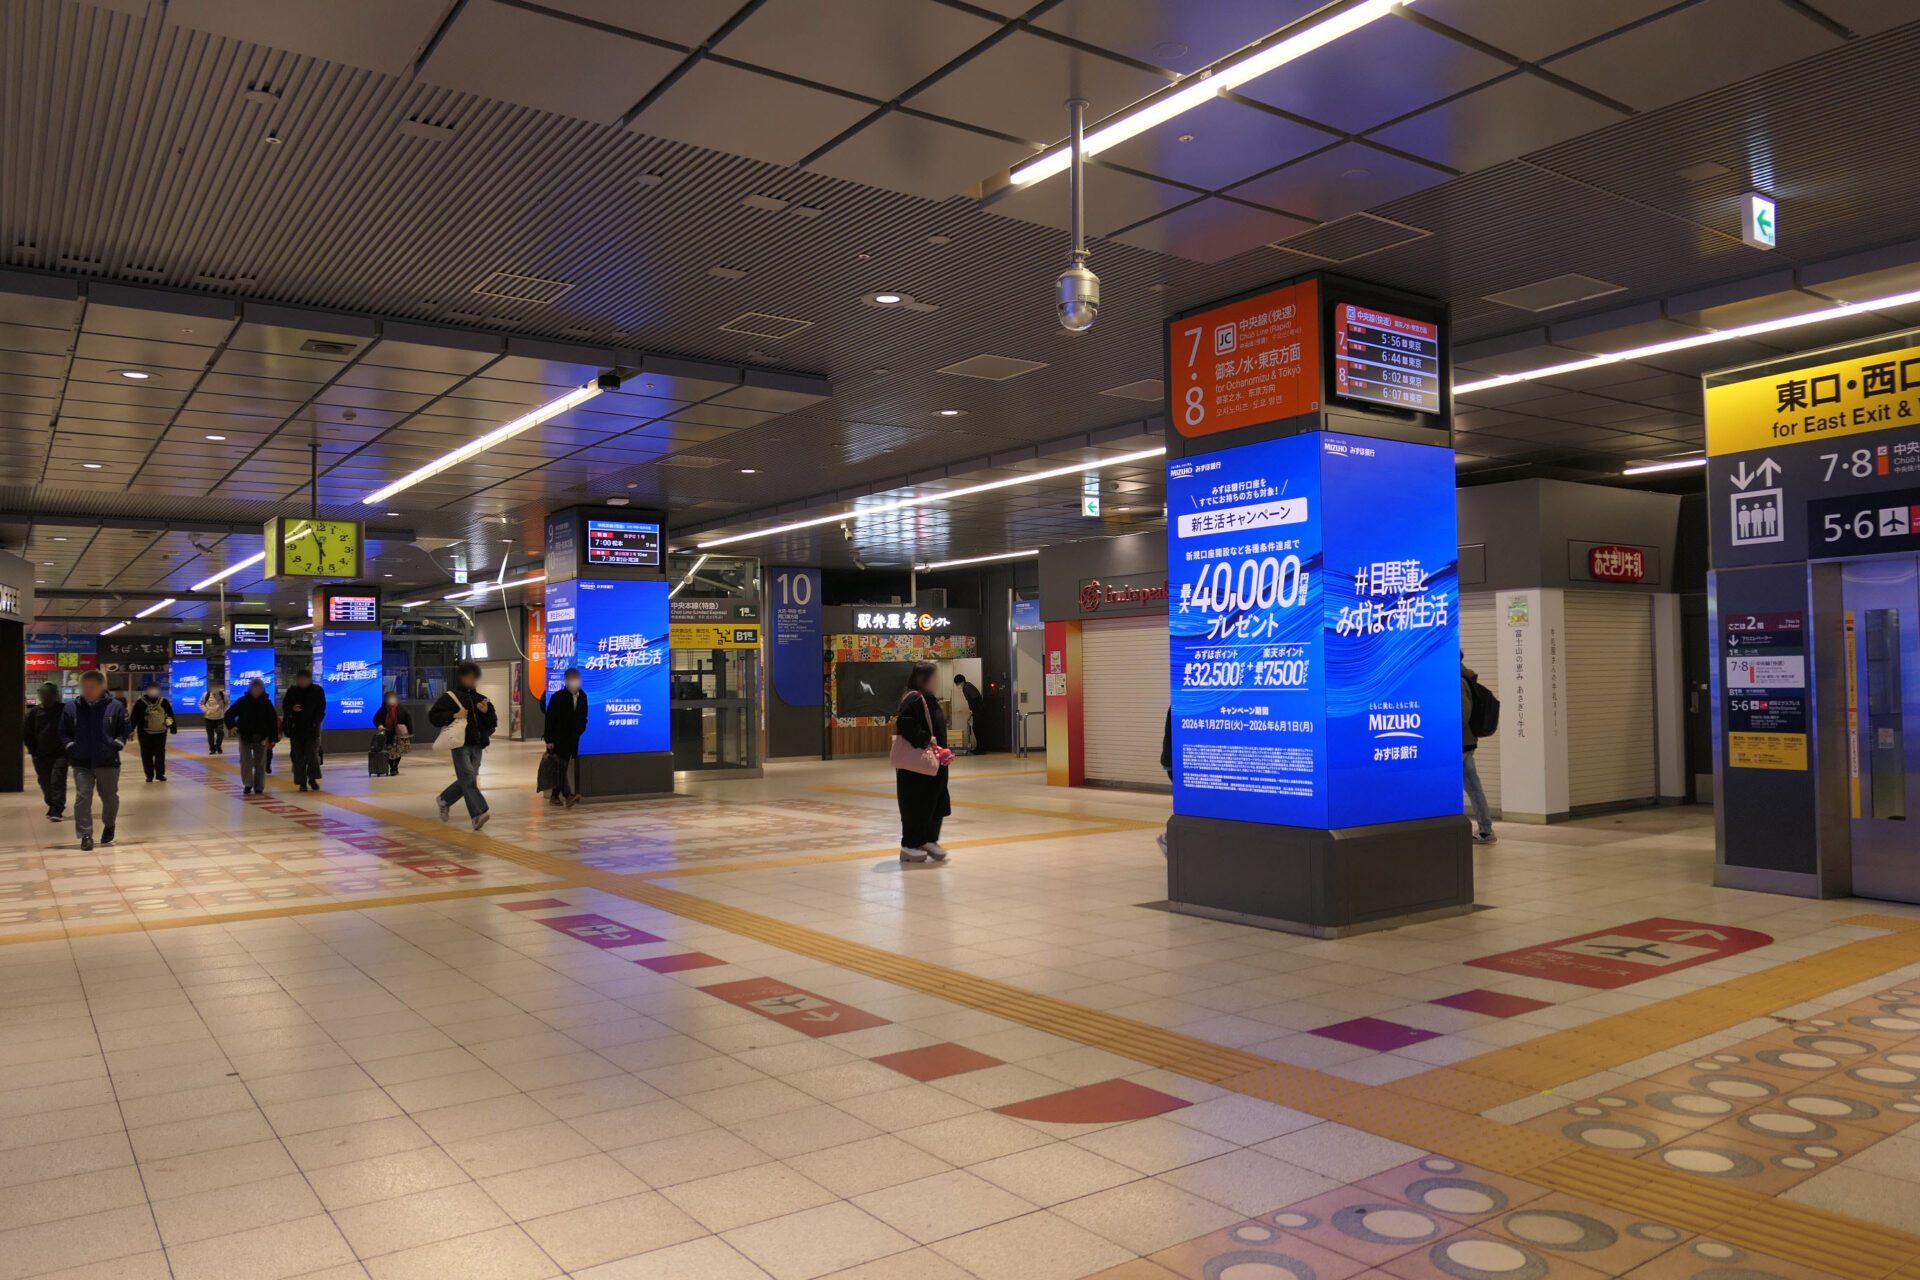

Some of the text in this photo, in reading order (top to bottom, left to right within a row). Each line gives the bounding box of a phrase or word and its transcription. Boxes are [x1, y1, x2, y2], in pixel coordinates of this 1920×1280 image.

[1219, 331, 1232, 346] JC
[1338, 331, 1345, 345] 7
[1381, 333, 1401, 347] 5:56
[1382, 351, 1401, 365] 6:44
[1215, 383, 1225, 394] for
[1226, 374, 1270, 391] Ochanomizu
[1270, 371, 1277, 380] &
[1339, 367, 1346, 382] 8
[1382, 370, 1402, 384] 6:02
[1382, 387, 1402, 401] 6:07
[1772, 399, 1913, 438] for East Exit &
[1211, 478, 1267, 496] みずほ銀行口座を
[1191, 506, 1291, 533] 新生活キャンペーン
[594, 539, 612, 547] 7:00
[1185, 539, 1300, 561] 新規口座開設など各種条件達成で
[777, 573, 811, 606] 10
[1178, 583, 1192, 613] 最大
[1190, 554, 1301, 613] 40,000
[1104, 584, 1138, 603] fruits
[857, 613, 900, 630] 駅弁屋
[1335, 593, 1449, 638] みずほで新生活
[1207, 613, 1279, 640] プレゼント
[584, 649, 662, 670] みずほで新生活
[1194, 649, 1239, 660] みずほポイント
[1262, 647, 1305, 658] 楽天ポイント
[1191, 662, 1241, 686] 32,500
[1263, 660, 1304, 686] 7,500
[605, 703, 641, 712] MIZUHO
[1220, 706, 1270, 716] キャンペーン期間
[1369, 713, 1421, 731] MIZUHO
[1373, 745, 1418, 761] みずほ銀行
